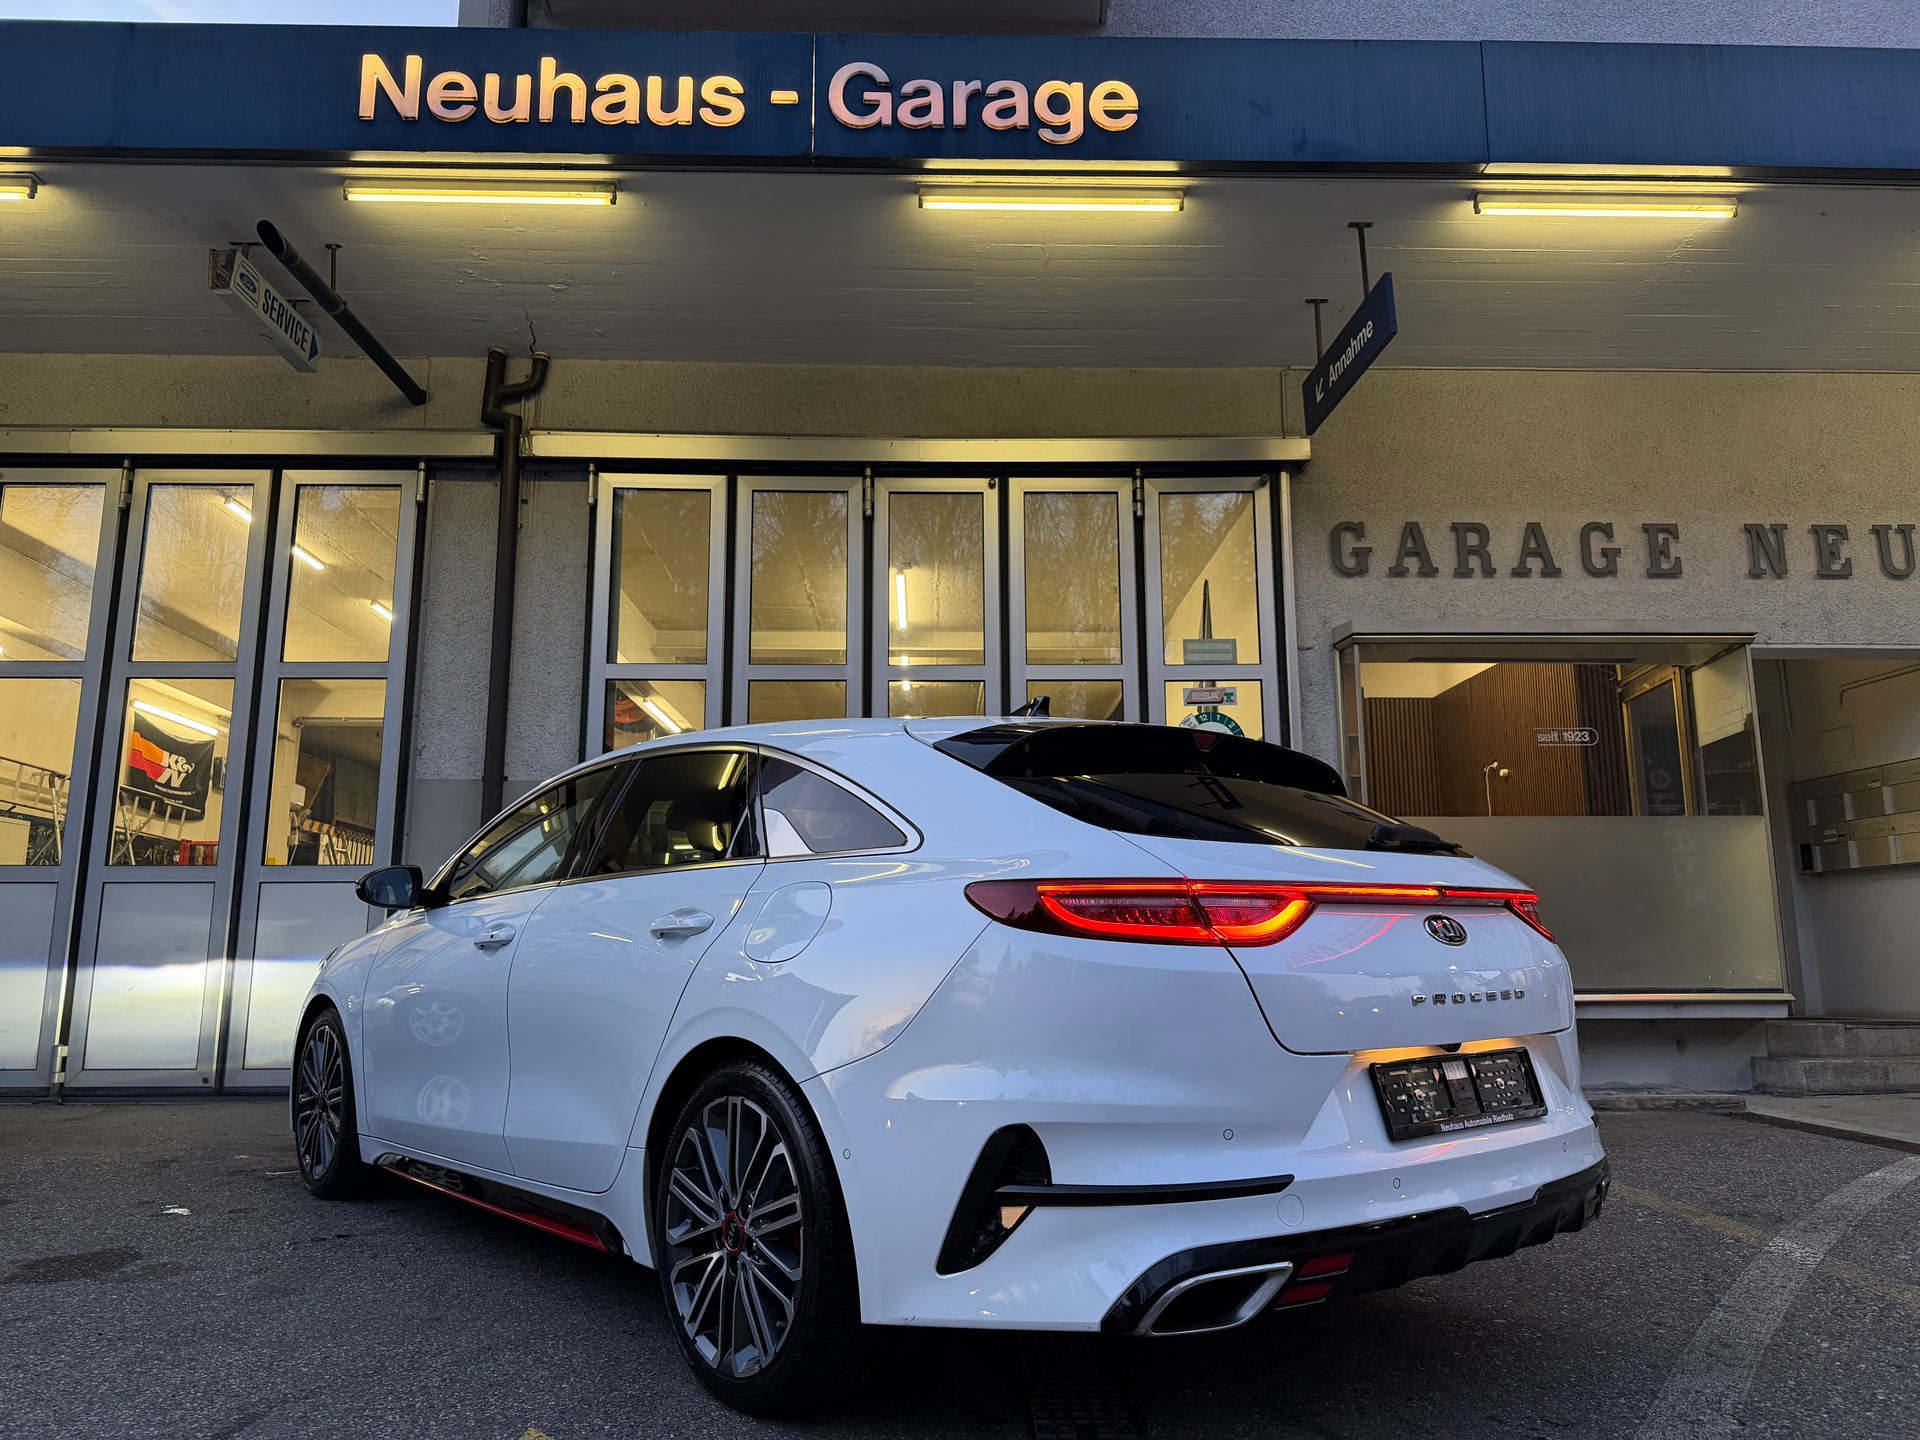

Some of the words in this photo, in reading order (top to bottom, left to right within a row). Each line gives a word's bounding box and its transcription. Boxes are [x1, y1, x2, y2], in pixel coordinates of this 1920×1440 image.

[358, 53, 746, 127] Neuhaus
[828, 61, 1140, 145] Garage
[262, 288, 309, 352] SERVICE
[1329, 320, 1374, 388] Annahme
[1330, 521, 1683, 575] GARAGE
[1743, 523, 1916, 576] NEU
[1192, 692, 1219, 700] ESA
[1199, 714, 1209, 722] 12
[1228, 721, 1236, 729] 2
[1537, 731, 1558, 742] seit
[1562, 731, 1590, 742] 1923
[1411, 987, 1525, 1006] PROCEED
[1440, 1122, 1465, 1132] Neuhaus
[1464, 1116, 1493, 1128] Automobile
[1492, 1112, 1515, 1123] Riedholz
